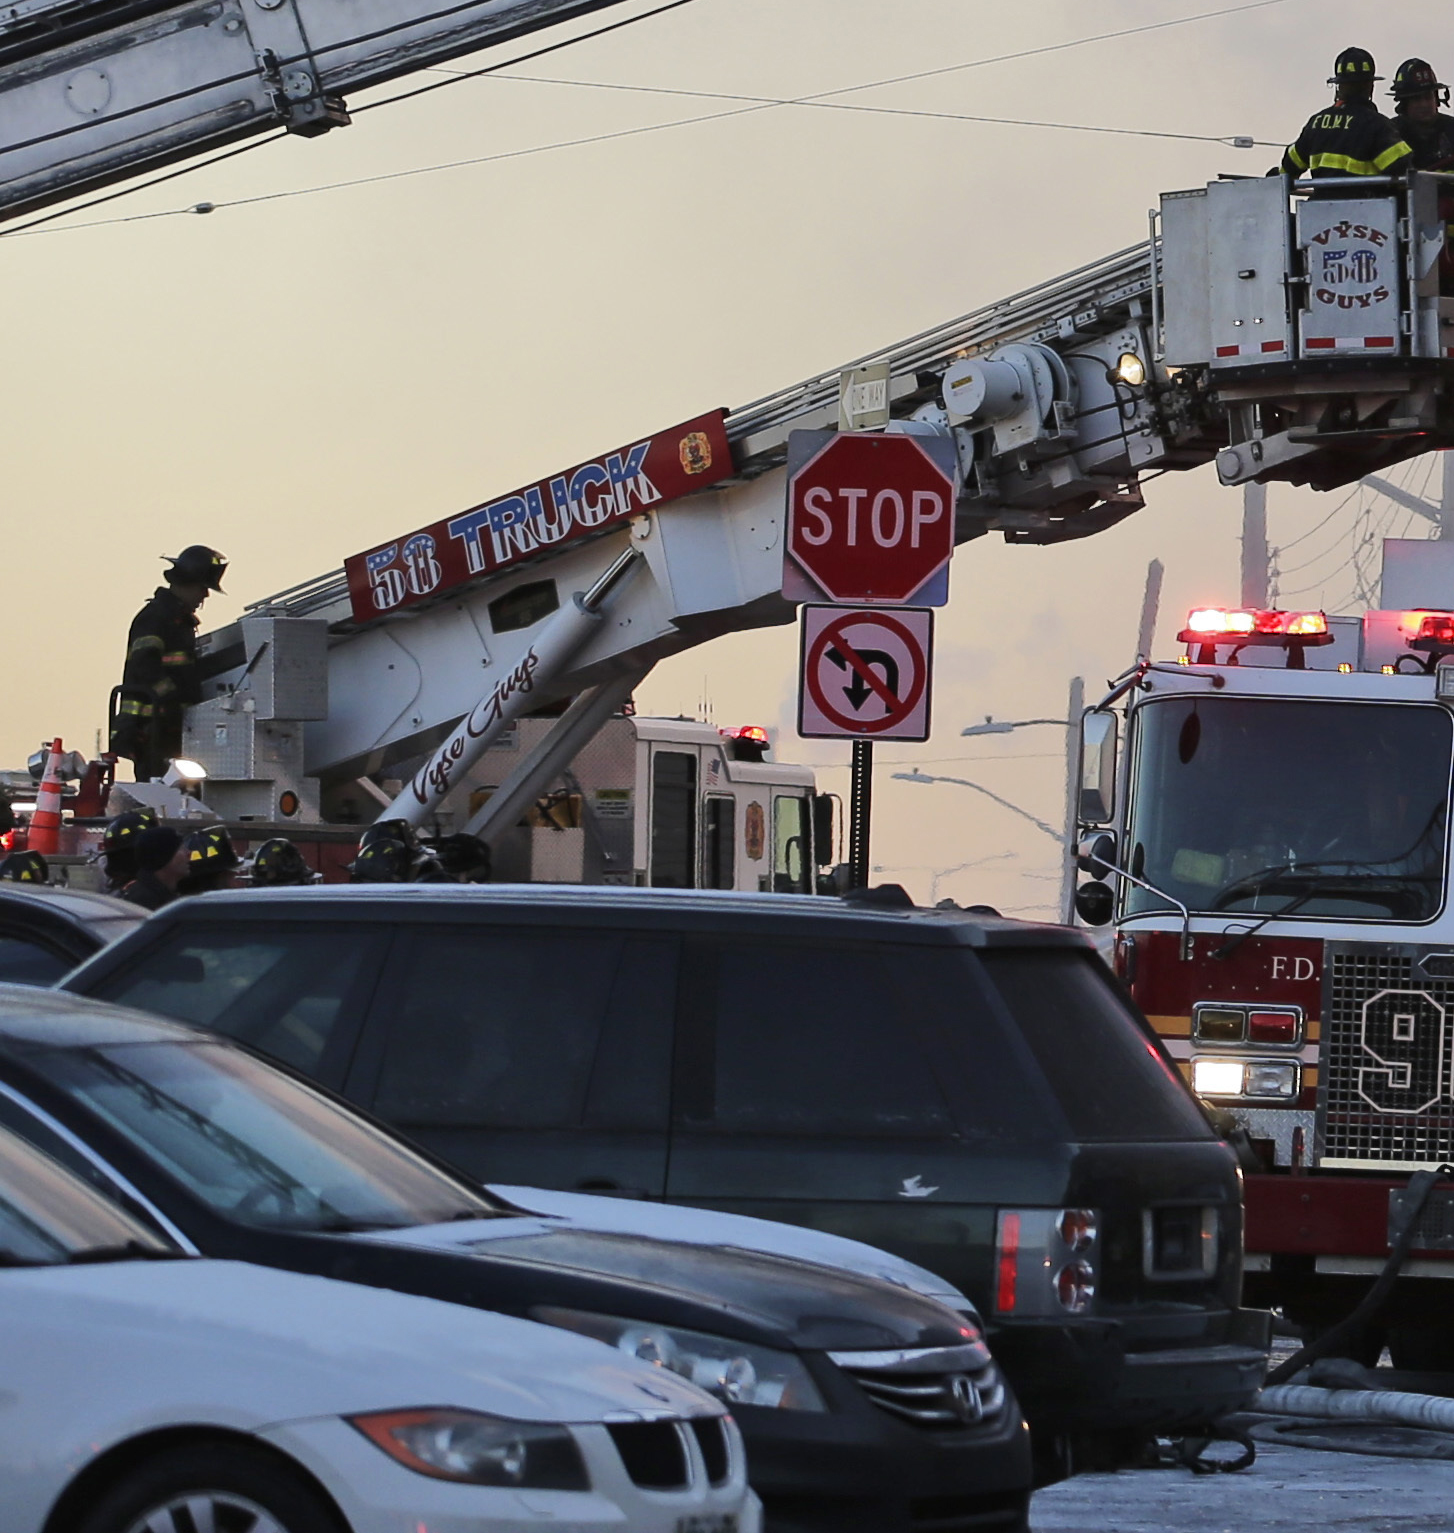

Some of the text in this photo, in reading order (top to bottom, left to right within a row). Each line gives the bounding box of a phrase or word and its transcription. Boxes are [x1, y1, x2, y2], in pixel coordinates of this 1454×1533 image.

[1311, 223, 1389, 248] VYSE
[1322, 249, 1378, 284] 58
[1316, 285, 1390, 310] GUYS
[365, 440, 663, 611] 58 TRUCK
[802, 486, 944, 549] STOP
[467, 645, 539, 738] Guys
[412, 735, 465, 805] Vyse
[1270, 956, 1320, 981] F.D.
